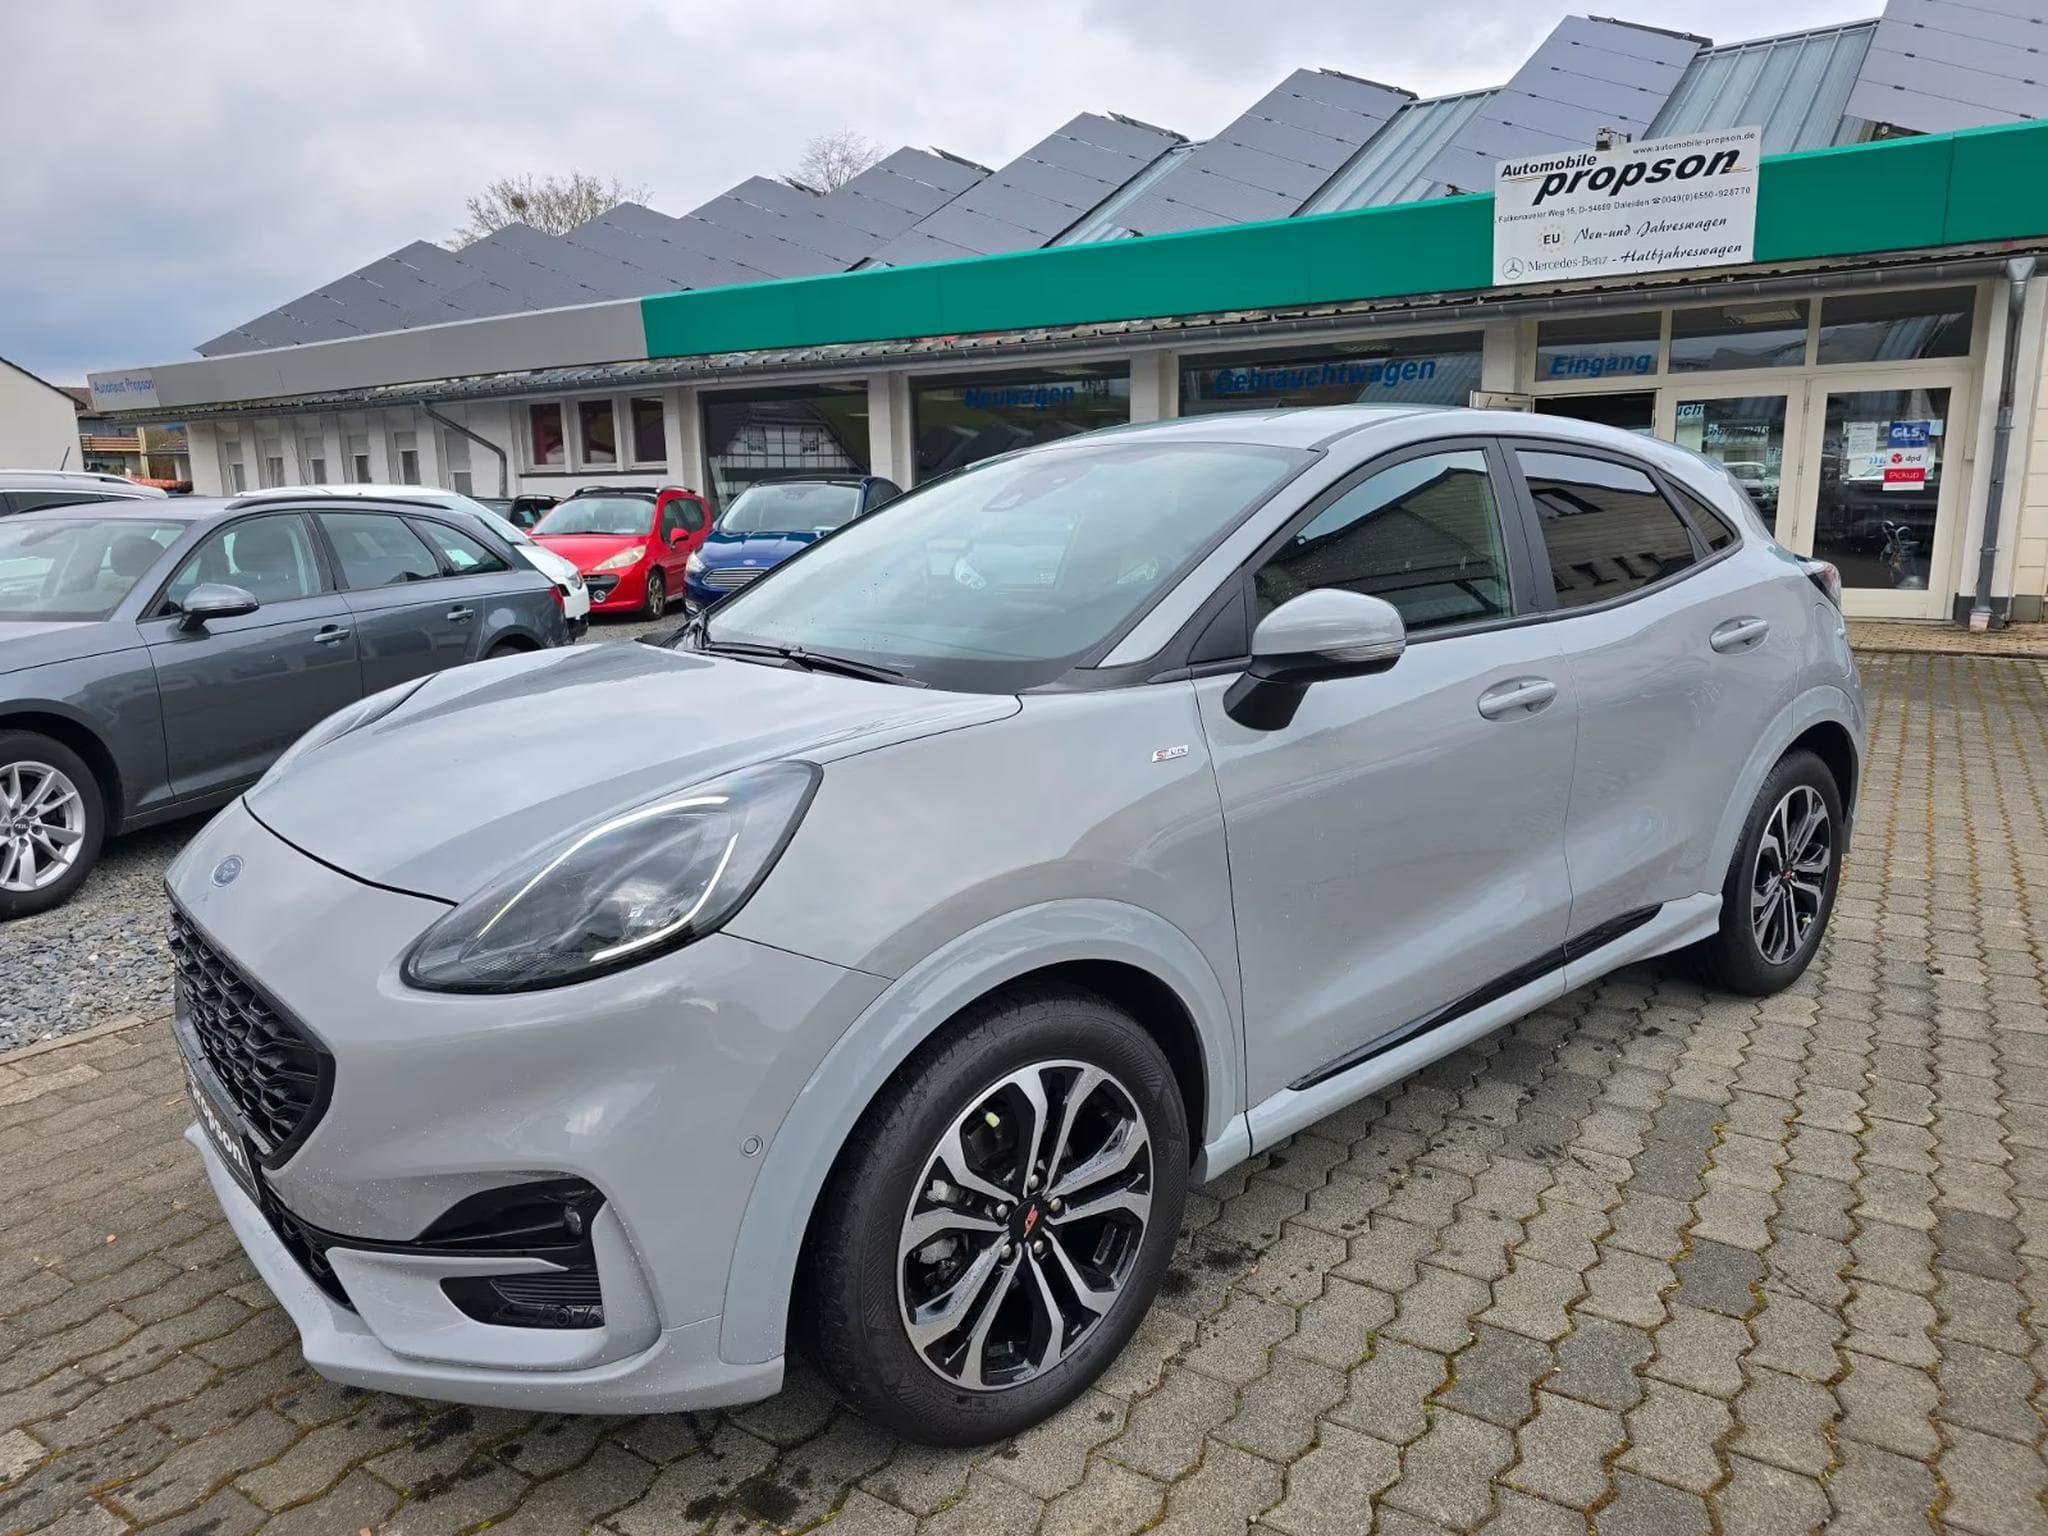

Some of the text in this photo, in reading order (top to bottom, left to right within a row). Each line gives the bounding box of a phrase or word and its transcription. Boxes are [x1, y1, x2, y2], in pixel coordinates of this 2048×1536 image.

[1501, 154, 1597, 178] Automobile
[1532, 149, 1740, 206] propson
[1548, 208, 1565, 217] Weg
[1614, 200, 1649, 210] Daleiden
[1636, 217, 1727, 238] Jahreswagen
[1543, 233, 1561, 245] EU
[1527, 255, 1608, 273] Mercedes-Benz
[1551, 353, 1652, 377] Eingang
[1215, 360, 1437, 393] Gebrauchtwagen
[963, 386, 1075, 411] Neuwagen
[1891, 426, 1920, 438] GLS
[1905, 455, 1922, 463] dpd
